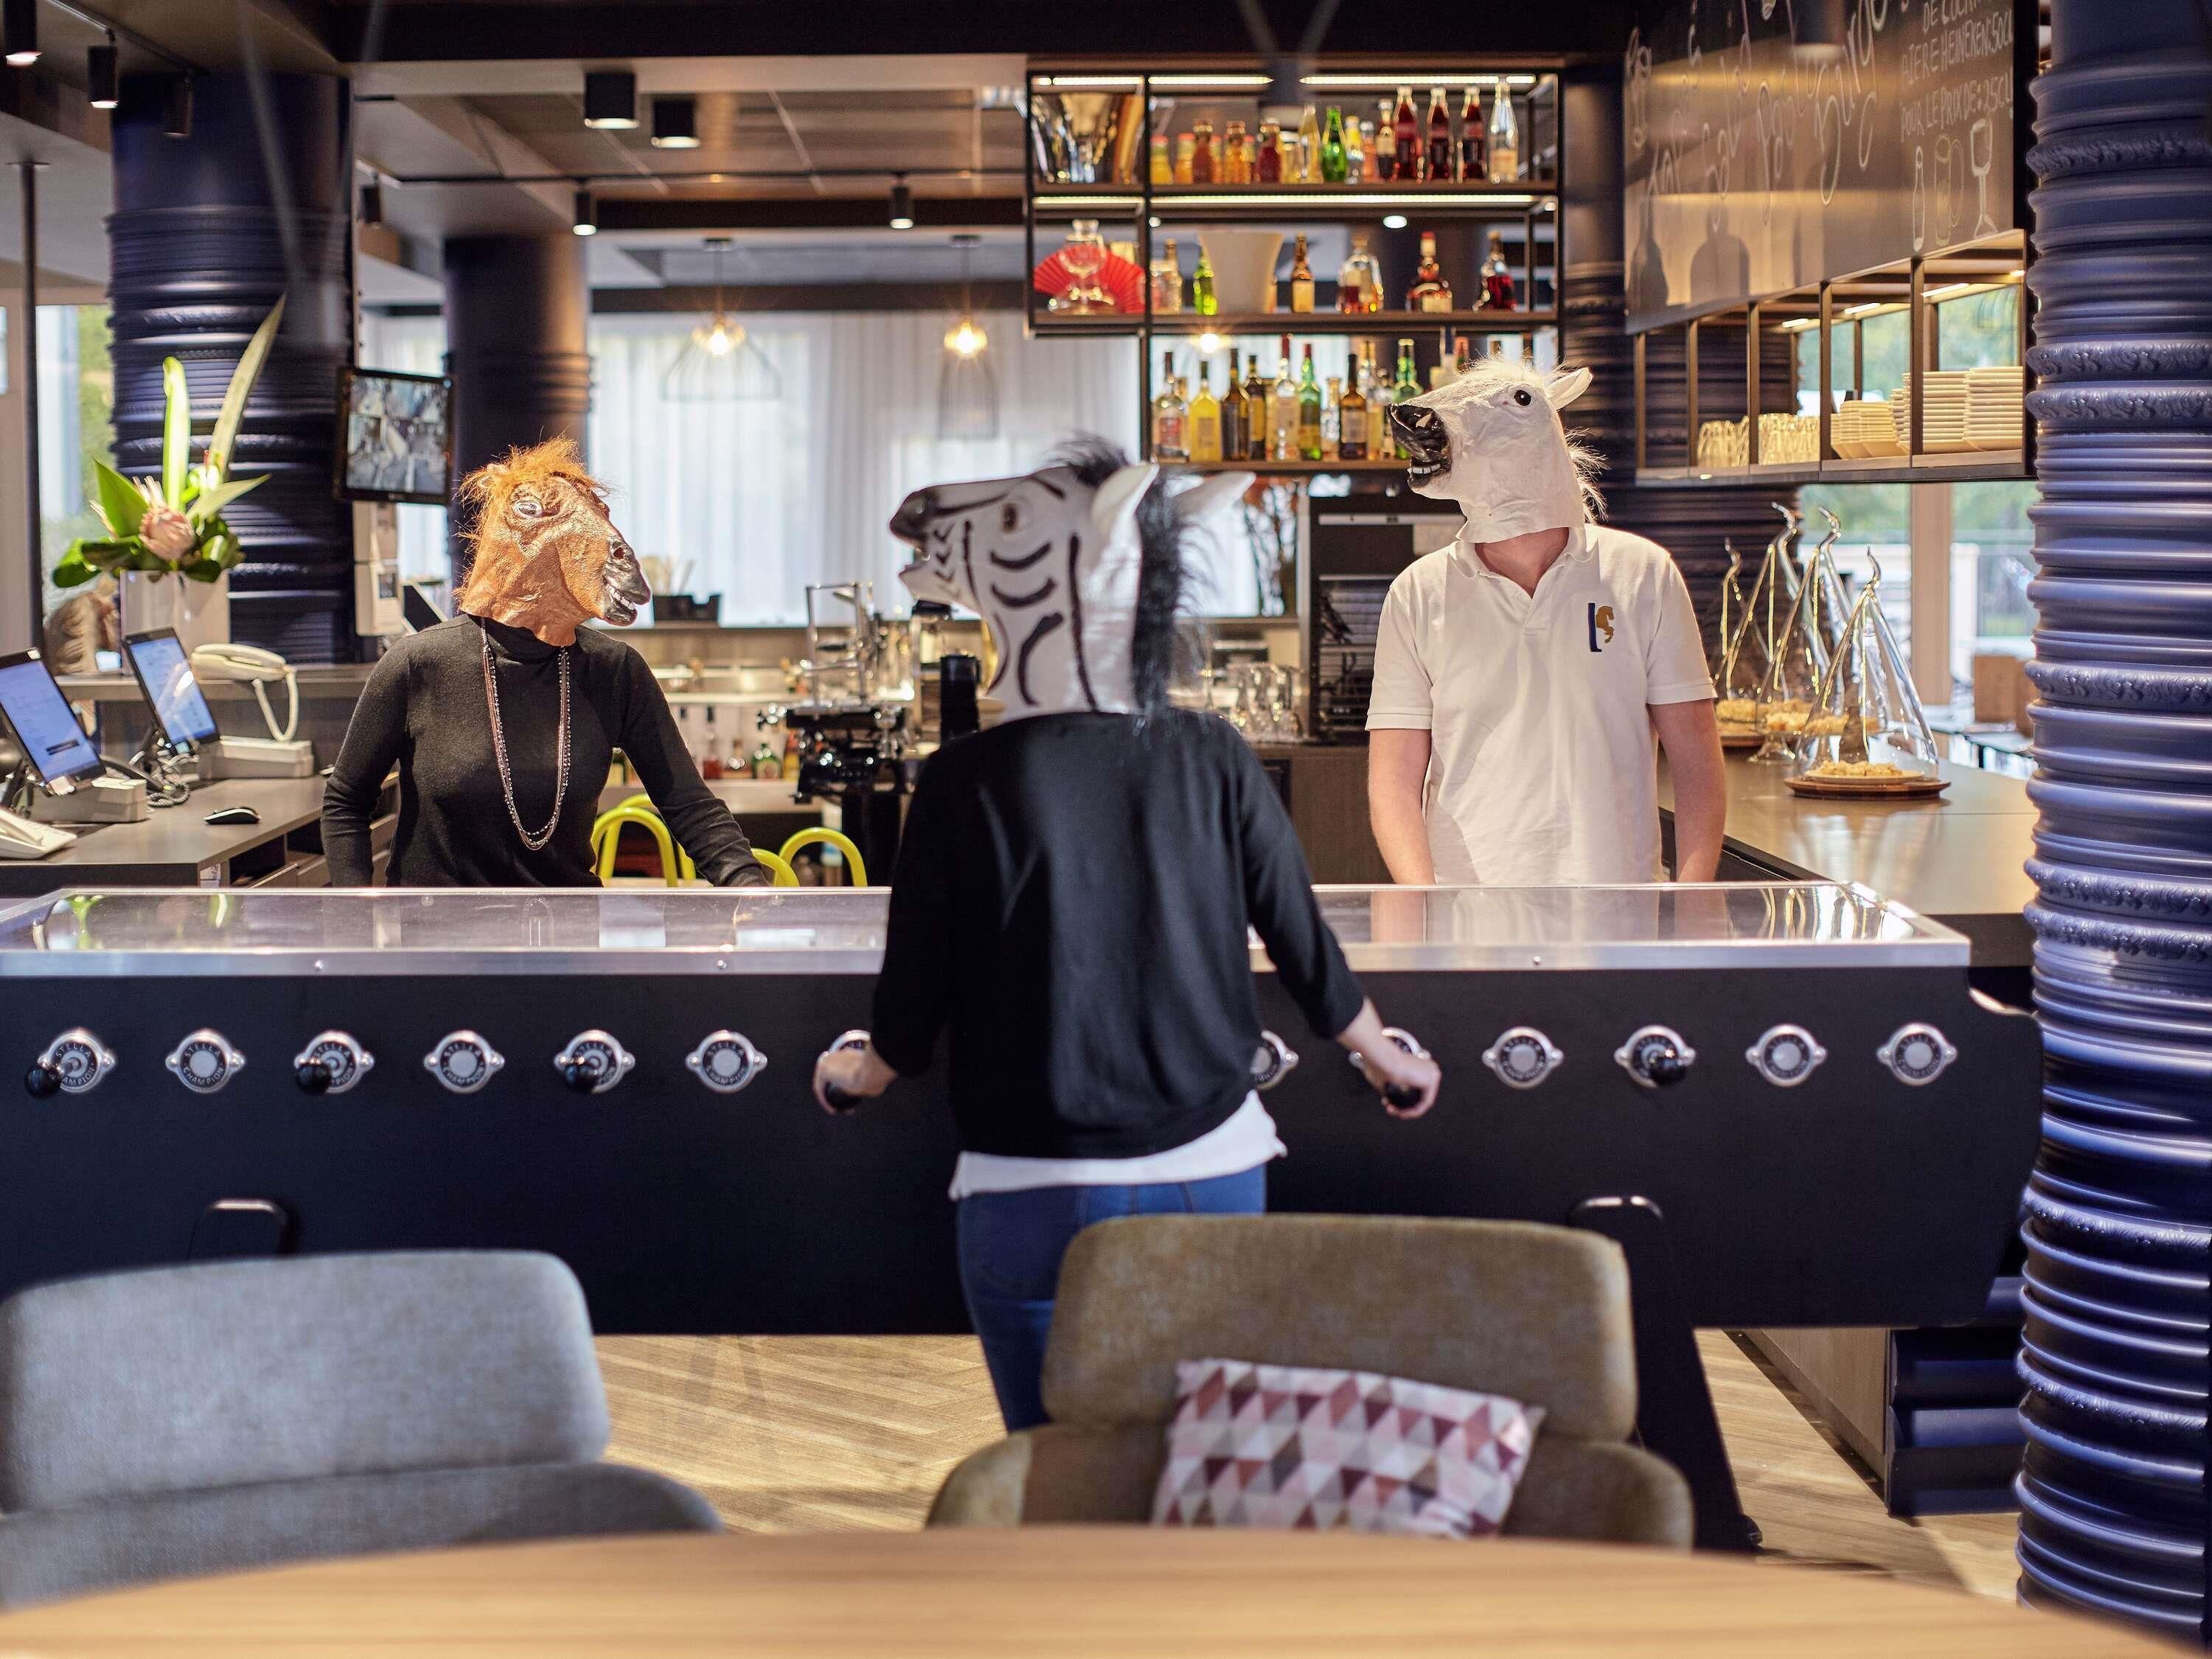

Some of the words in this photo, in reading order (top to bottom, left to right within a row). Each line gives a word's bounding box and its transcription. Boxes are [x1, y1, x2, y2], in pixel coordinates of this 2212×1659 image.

[55, 1043, 92, 1057] STELLA
[184, 1043, 224, 1057] STELLA
[63, 1067, 95, 1085] AMPION
[183, 1066, 225, 1085] CHAMPION
